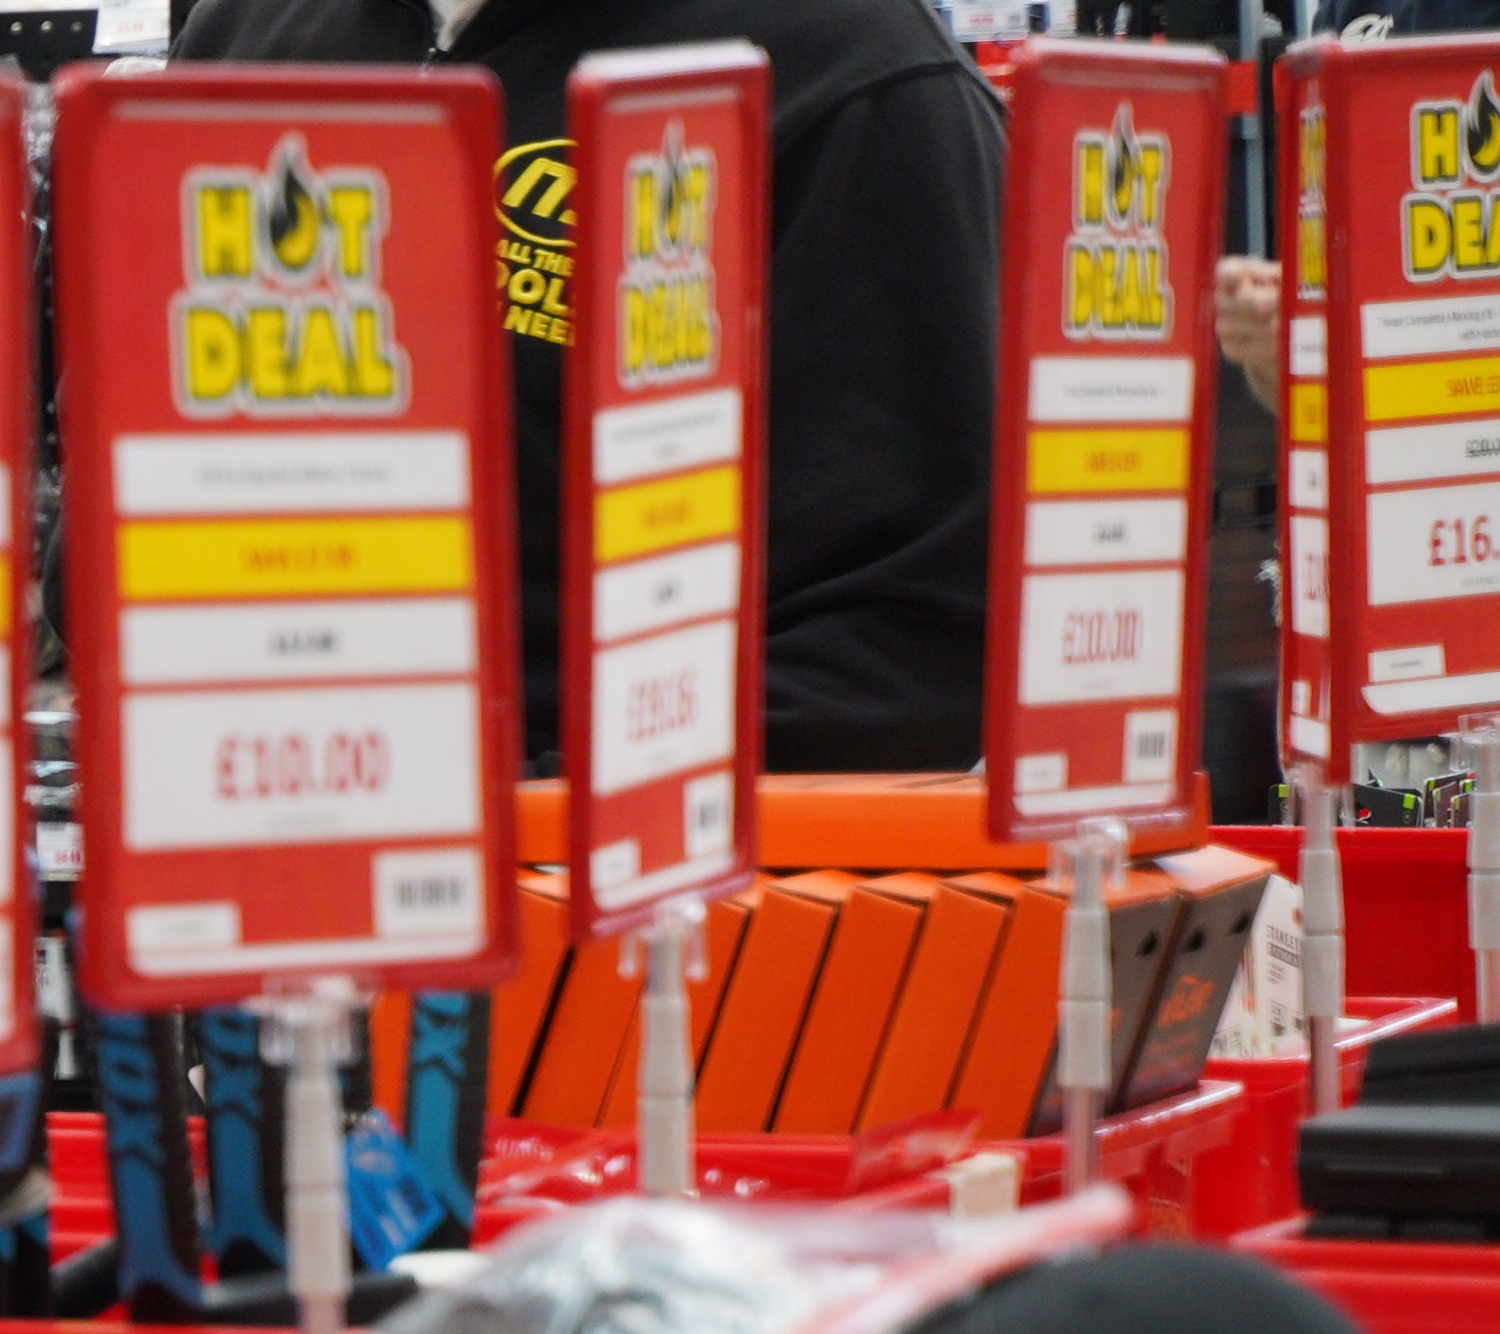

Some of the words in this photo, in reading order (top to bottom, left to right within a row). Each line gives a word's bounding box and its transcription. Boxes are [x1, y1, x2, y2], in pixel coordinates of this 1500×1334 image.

[185, 137, 386, 275] HOT
[1076, 112, 1167, 227] HOT
[1067, 237, 1171, 336] DEAL
[181, 303, 398, 407] DEAL
